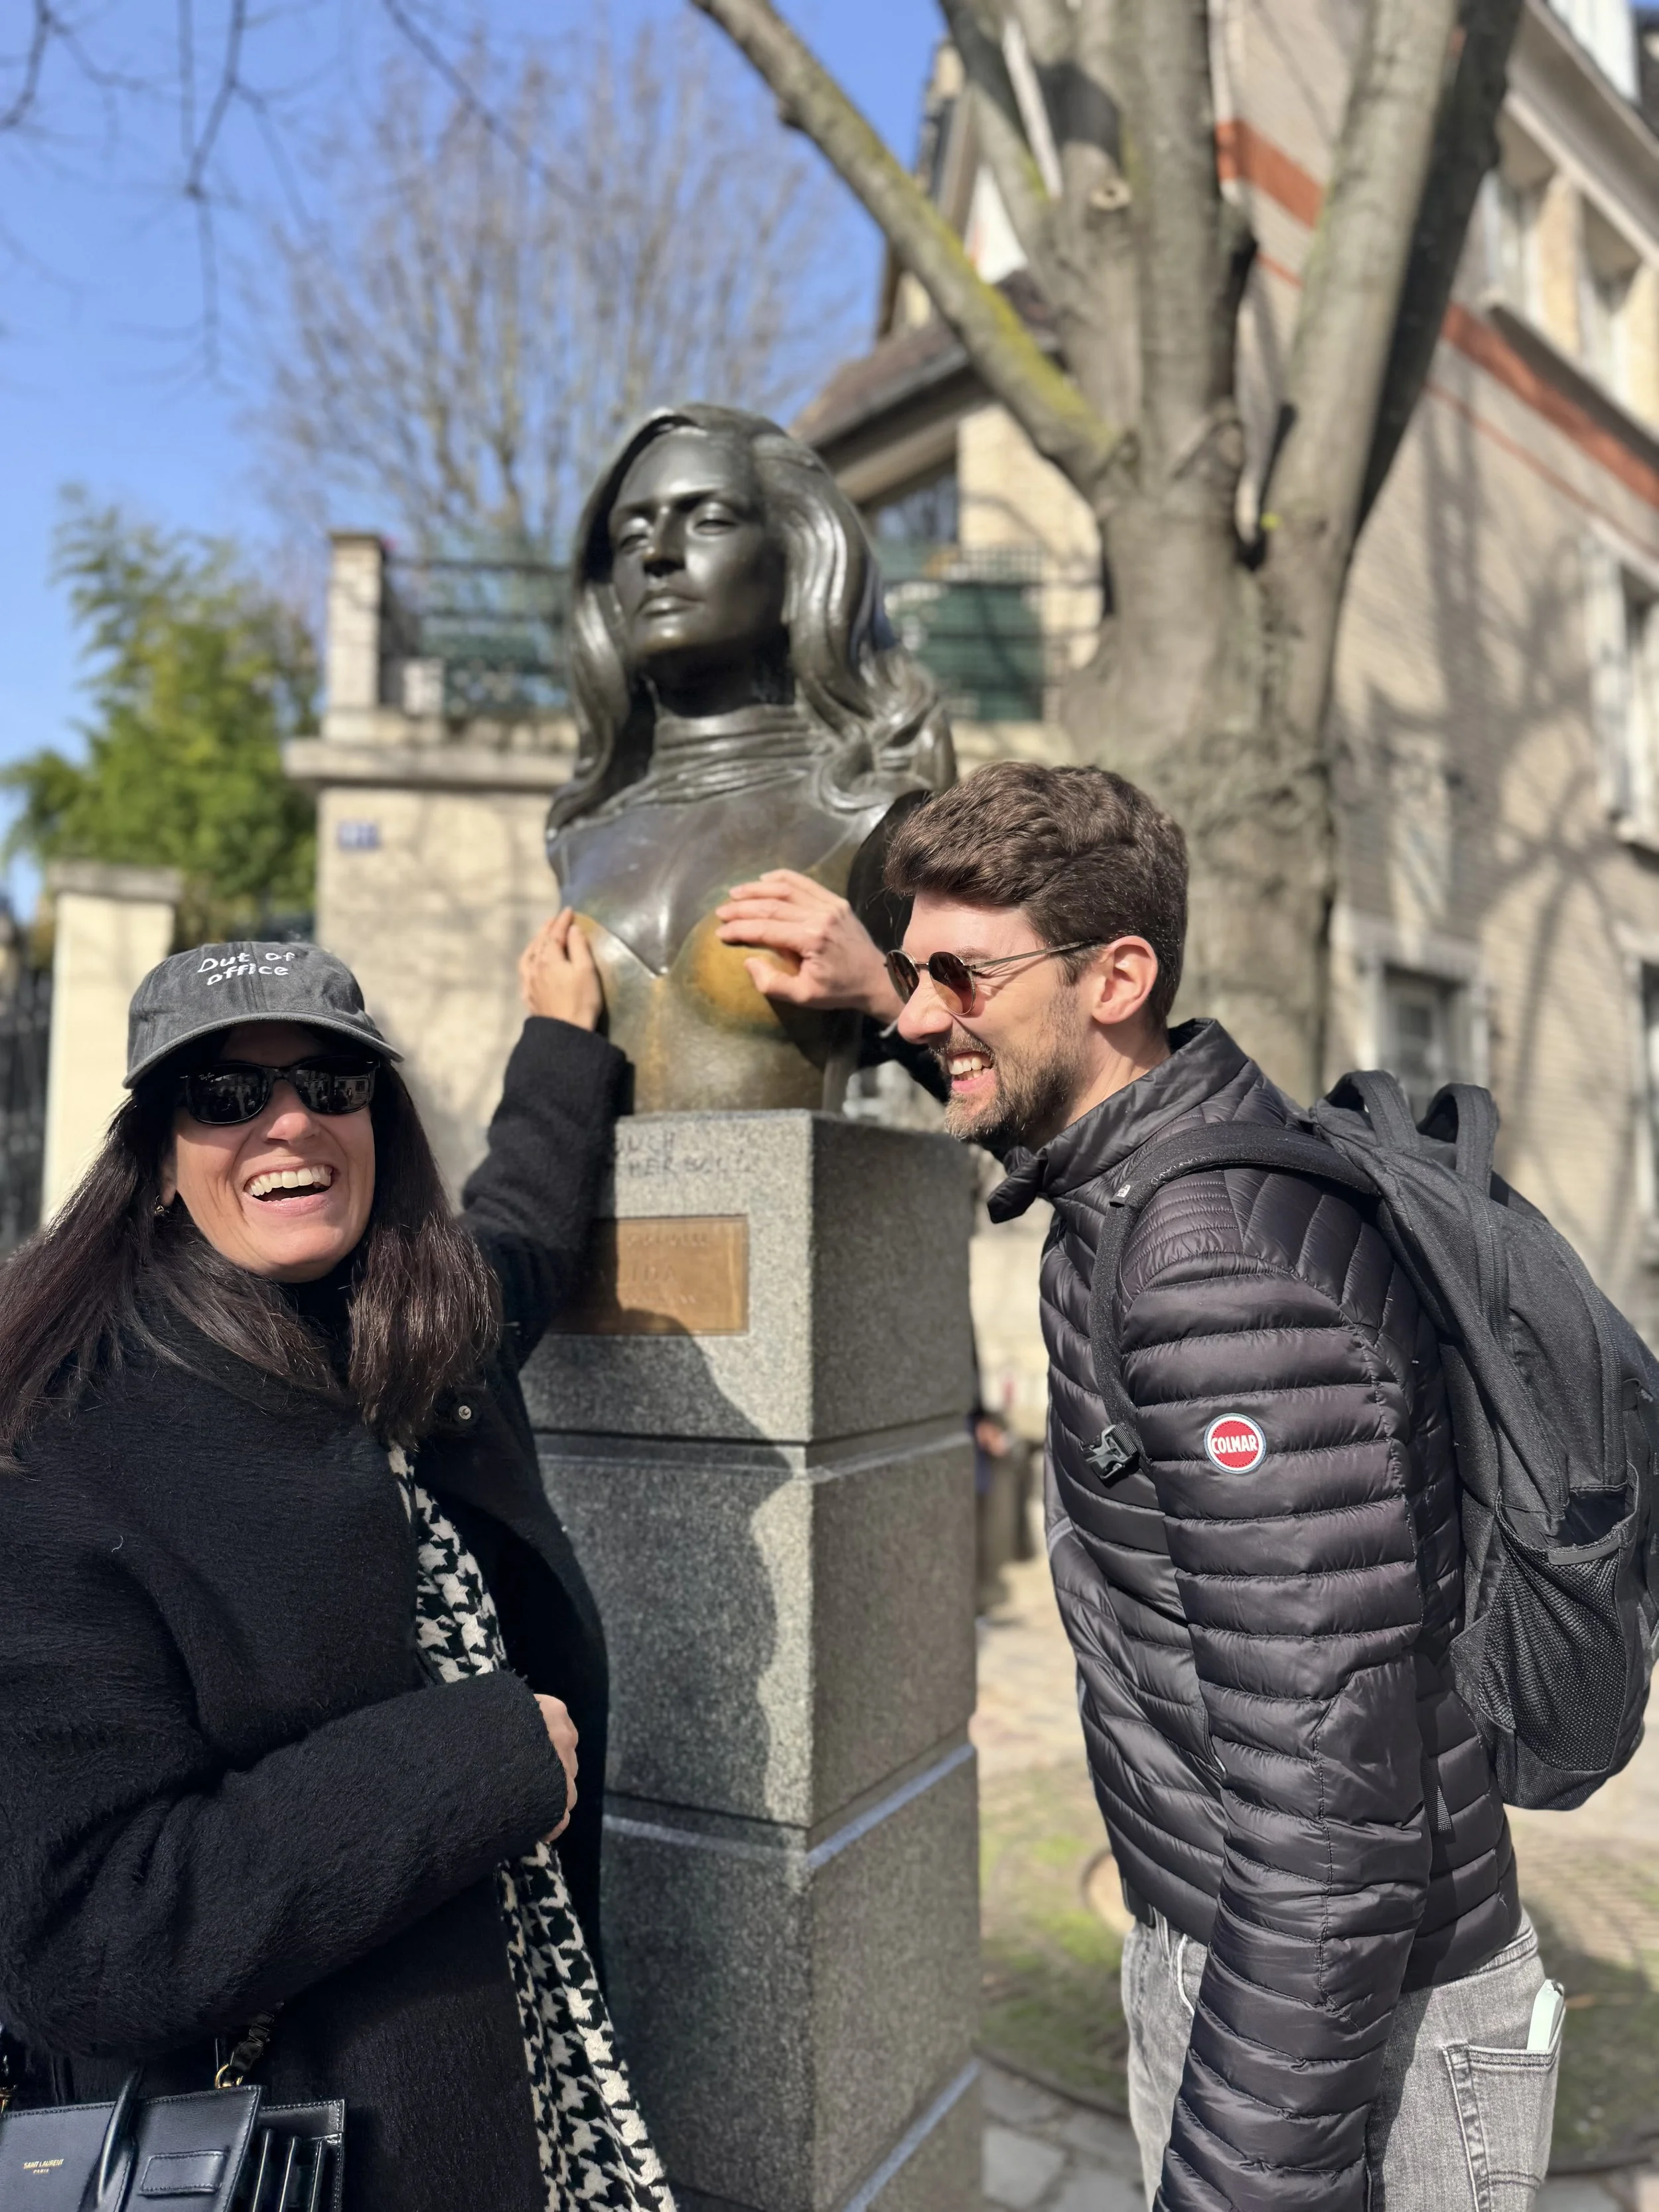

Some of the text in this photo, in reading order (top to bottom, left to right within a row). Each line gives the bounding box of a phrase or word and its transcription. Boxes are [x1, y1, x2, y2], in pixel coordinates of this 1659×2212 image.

[207, 963, 289, 986] office
[1211, 1434, 1258, 1454] COLMAR
[23, 2158, 64, 2170] SAINT LAURENT
